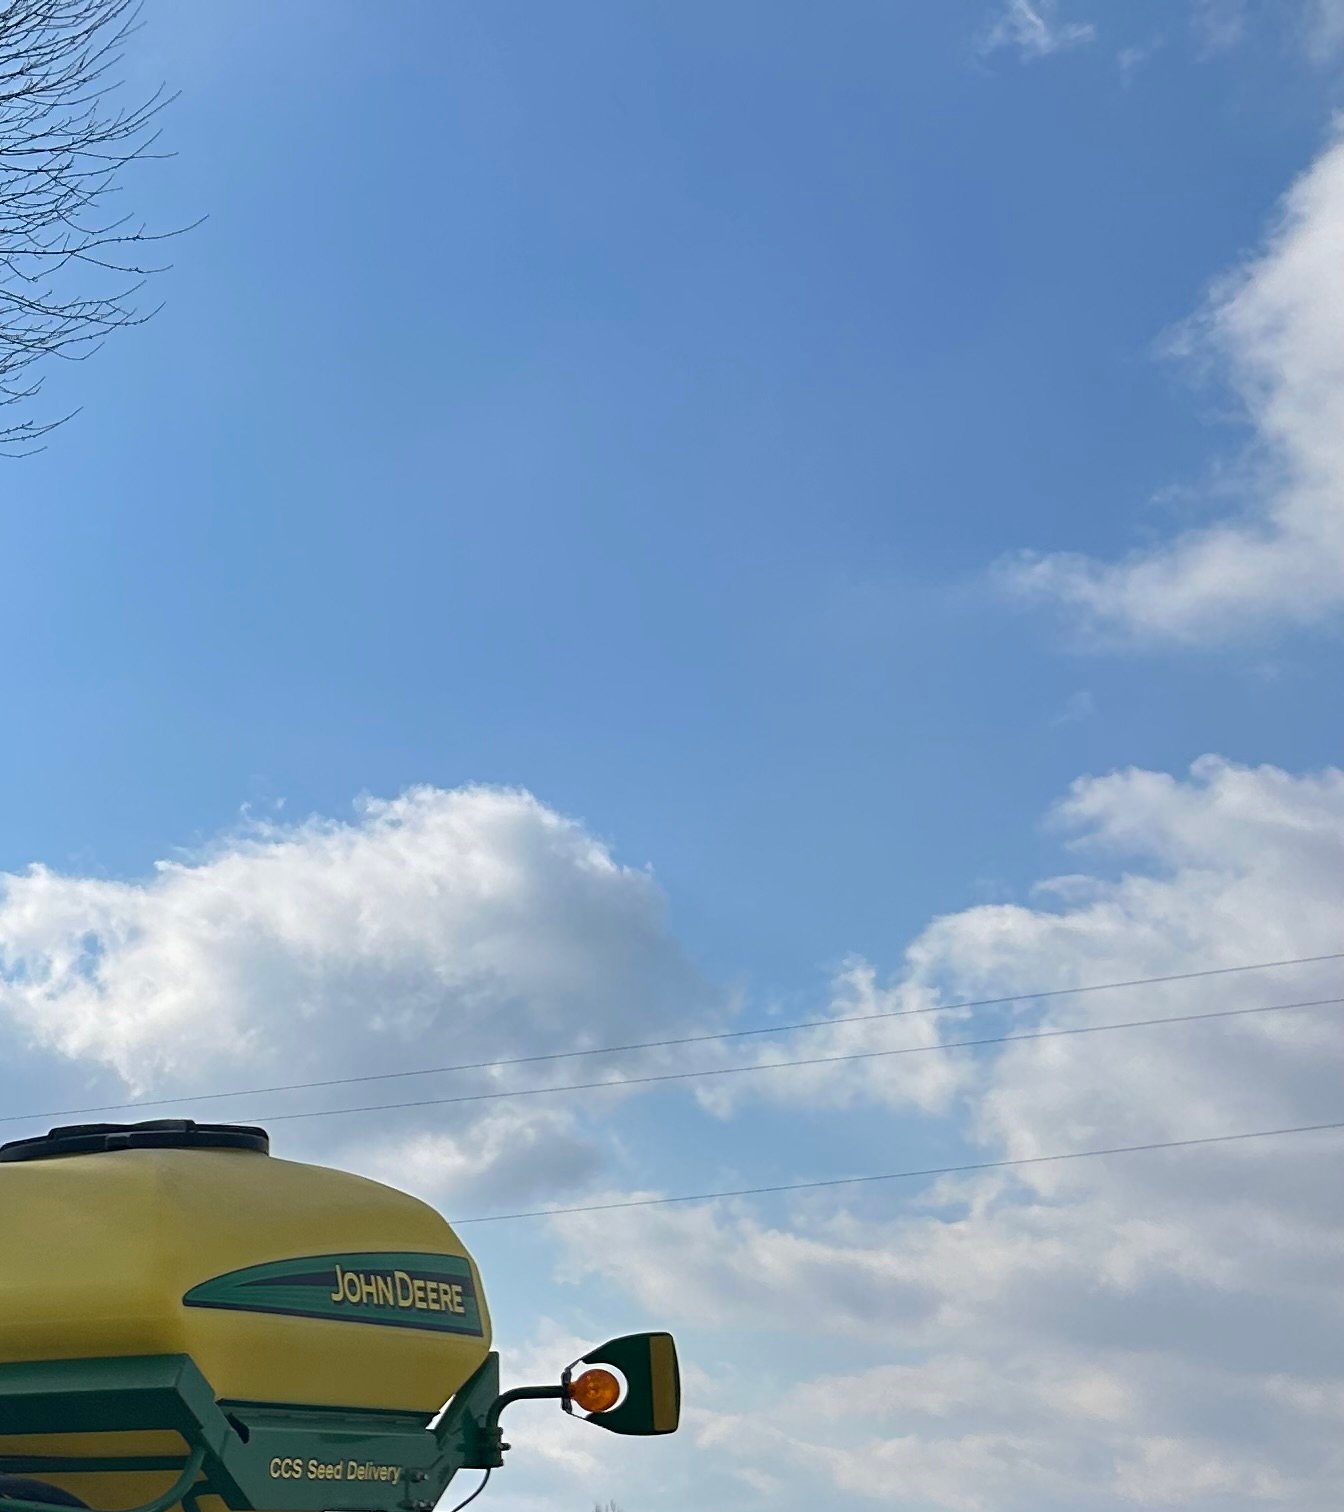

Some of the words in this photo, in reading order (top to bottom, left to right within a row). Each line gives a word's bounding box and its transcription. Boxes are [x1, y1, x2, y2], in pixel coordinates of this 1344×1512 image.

[331, 1264, 395, 1306] JOHN
[393, 1270, 465, 1314] DEERE
[270, 1457, 303, 1479] CCS
[307, 1459, 343, 1480] Seed
[346, 1460, 401, 1485] Delivery
